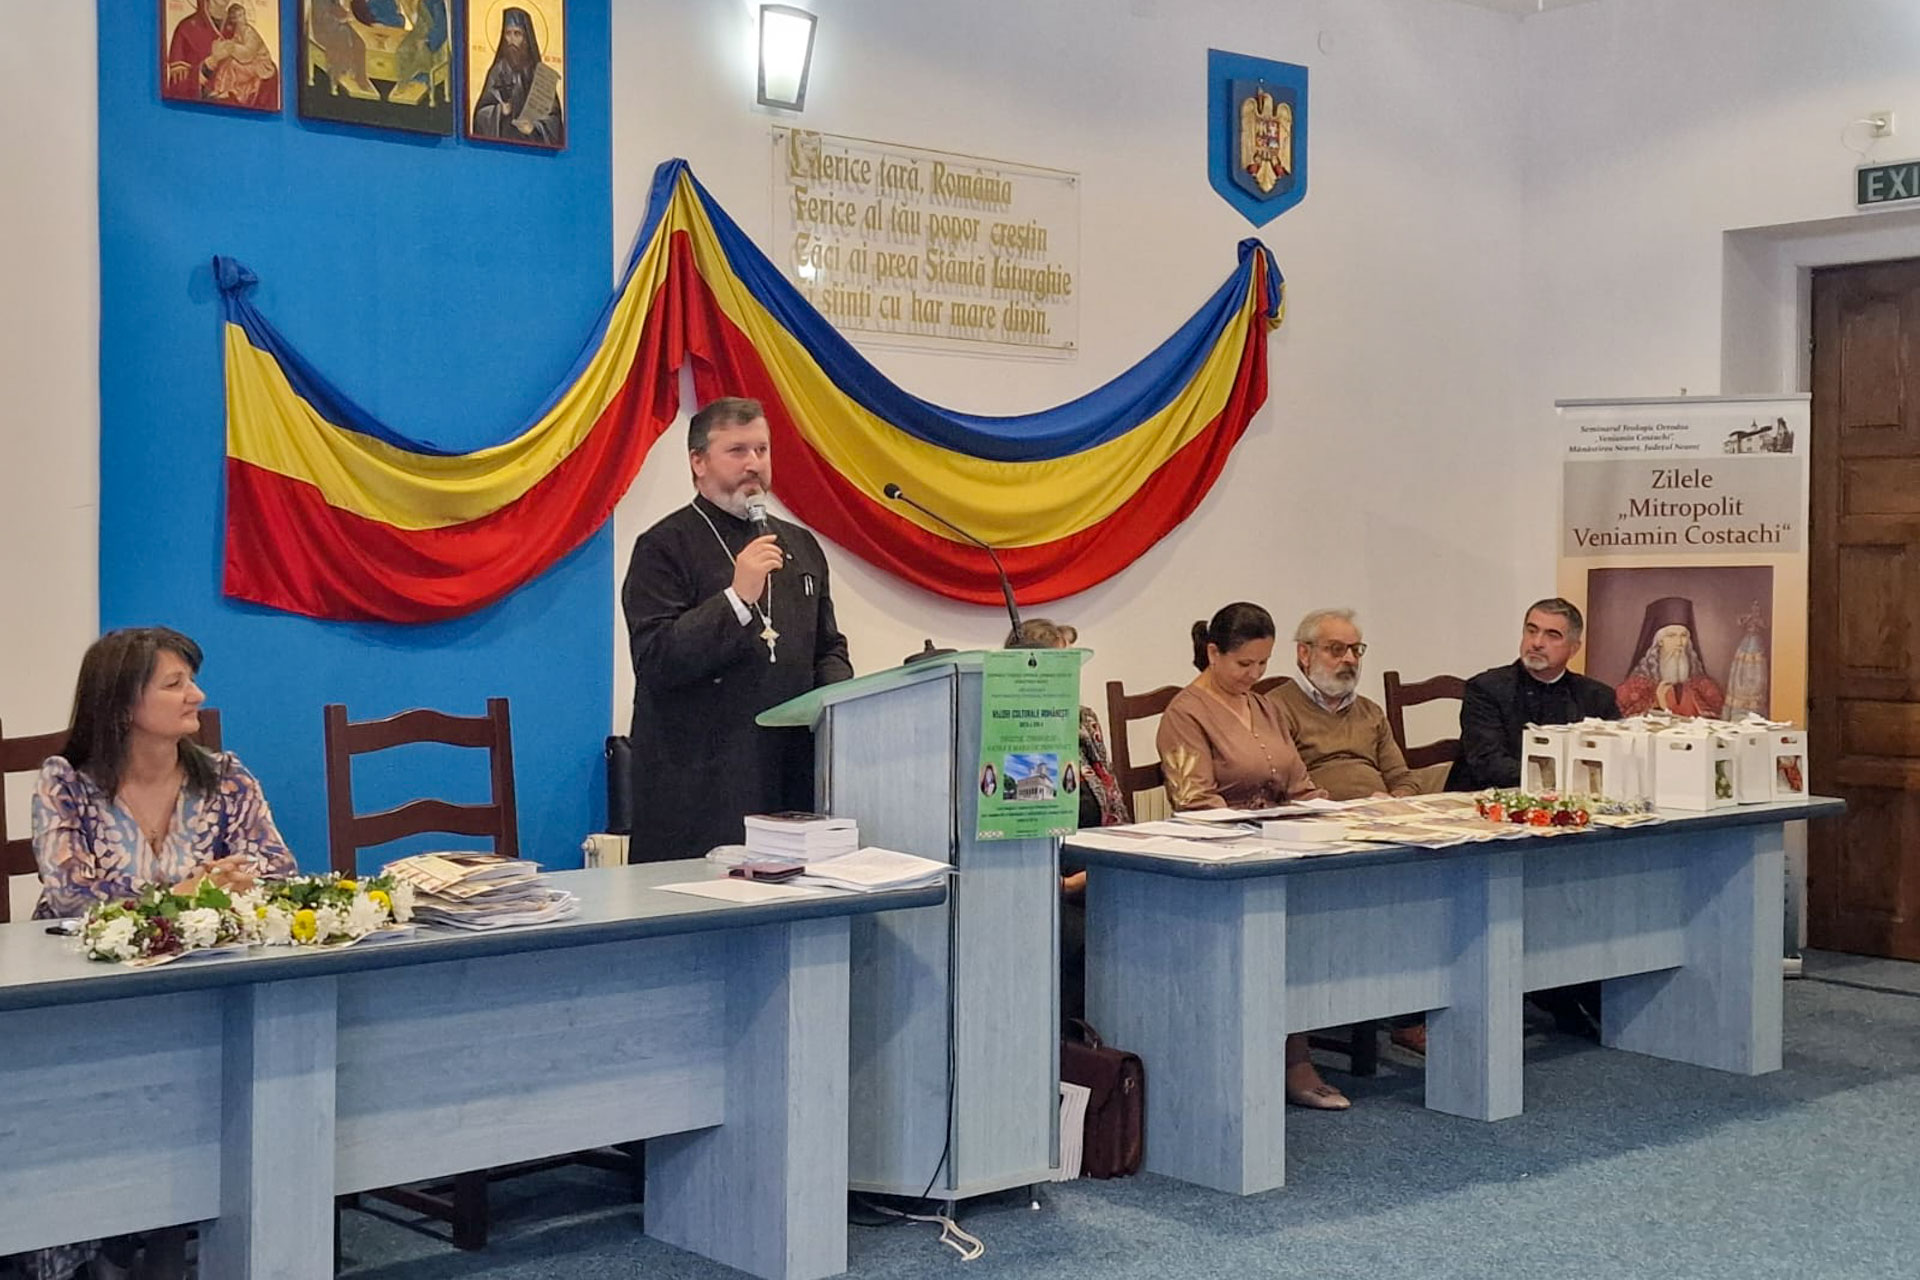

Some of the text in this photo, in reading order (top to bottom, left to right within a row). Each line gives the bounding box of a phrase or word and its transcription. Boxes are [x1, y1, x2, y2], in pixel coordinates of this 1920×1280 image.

[932, 160, 1013, 204] România
[795, 185, 857, 228] Ferice
[865, 199, 883, 231] al
[891, 203, 921, 235] tău
[928, 213, 981, 246] popor
[849, 241, 868, 274] ai
[876, 250, 919, 282] prea
[993, 255, 1072, 301] Liturghie
[879, 295, 902, 321] cu
[911, 290, 944, 325] har
[950, 301, 997, 330] mare
[1650, 469, 1713, 489] Zilele
[1617, 496, 1743, 522] „Mitropolit
[1573, 526, 1678, 548] Veniamin
